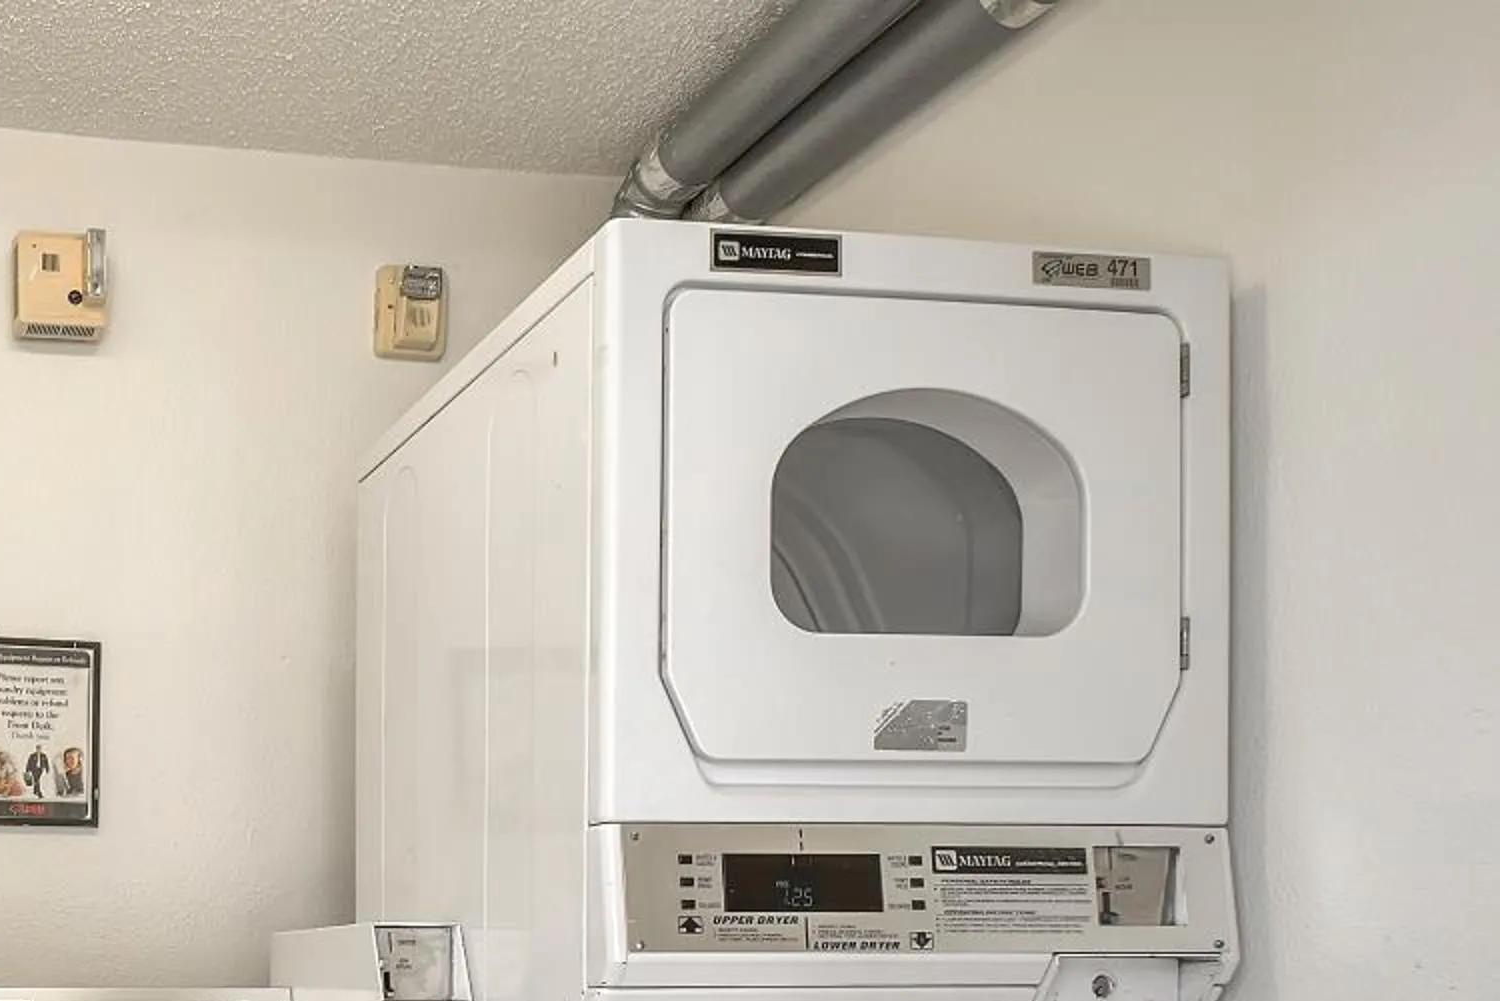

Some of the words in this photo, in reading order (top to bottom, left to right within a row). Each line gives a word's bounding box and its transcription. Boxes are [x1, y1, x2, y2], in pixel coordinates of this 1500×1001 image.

[741, 245, 791, 260] MAYTAG
[1062, 262, 1098, 277] WEB
[1107, 259, 1137, 277] 471
[959, 855, 1011, 867] MAYTAG
[713, 915, 754, 925] UPPER
[757, 915, 799, 925] DRYER
[813, 941, 857, 951] LOWER
[860, 941, 901, 951] DRYER
